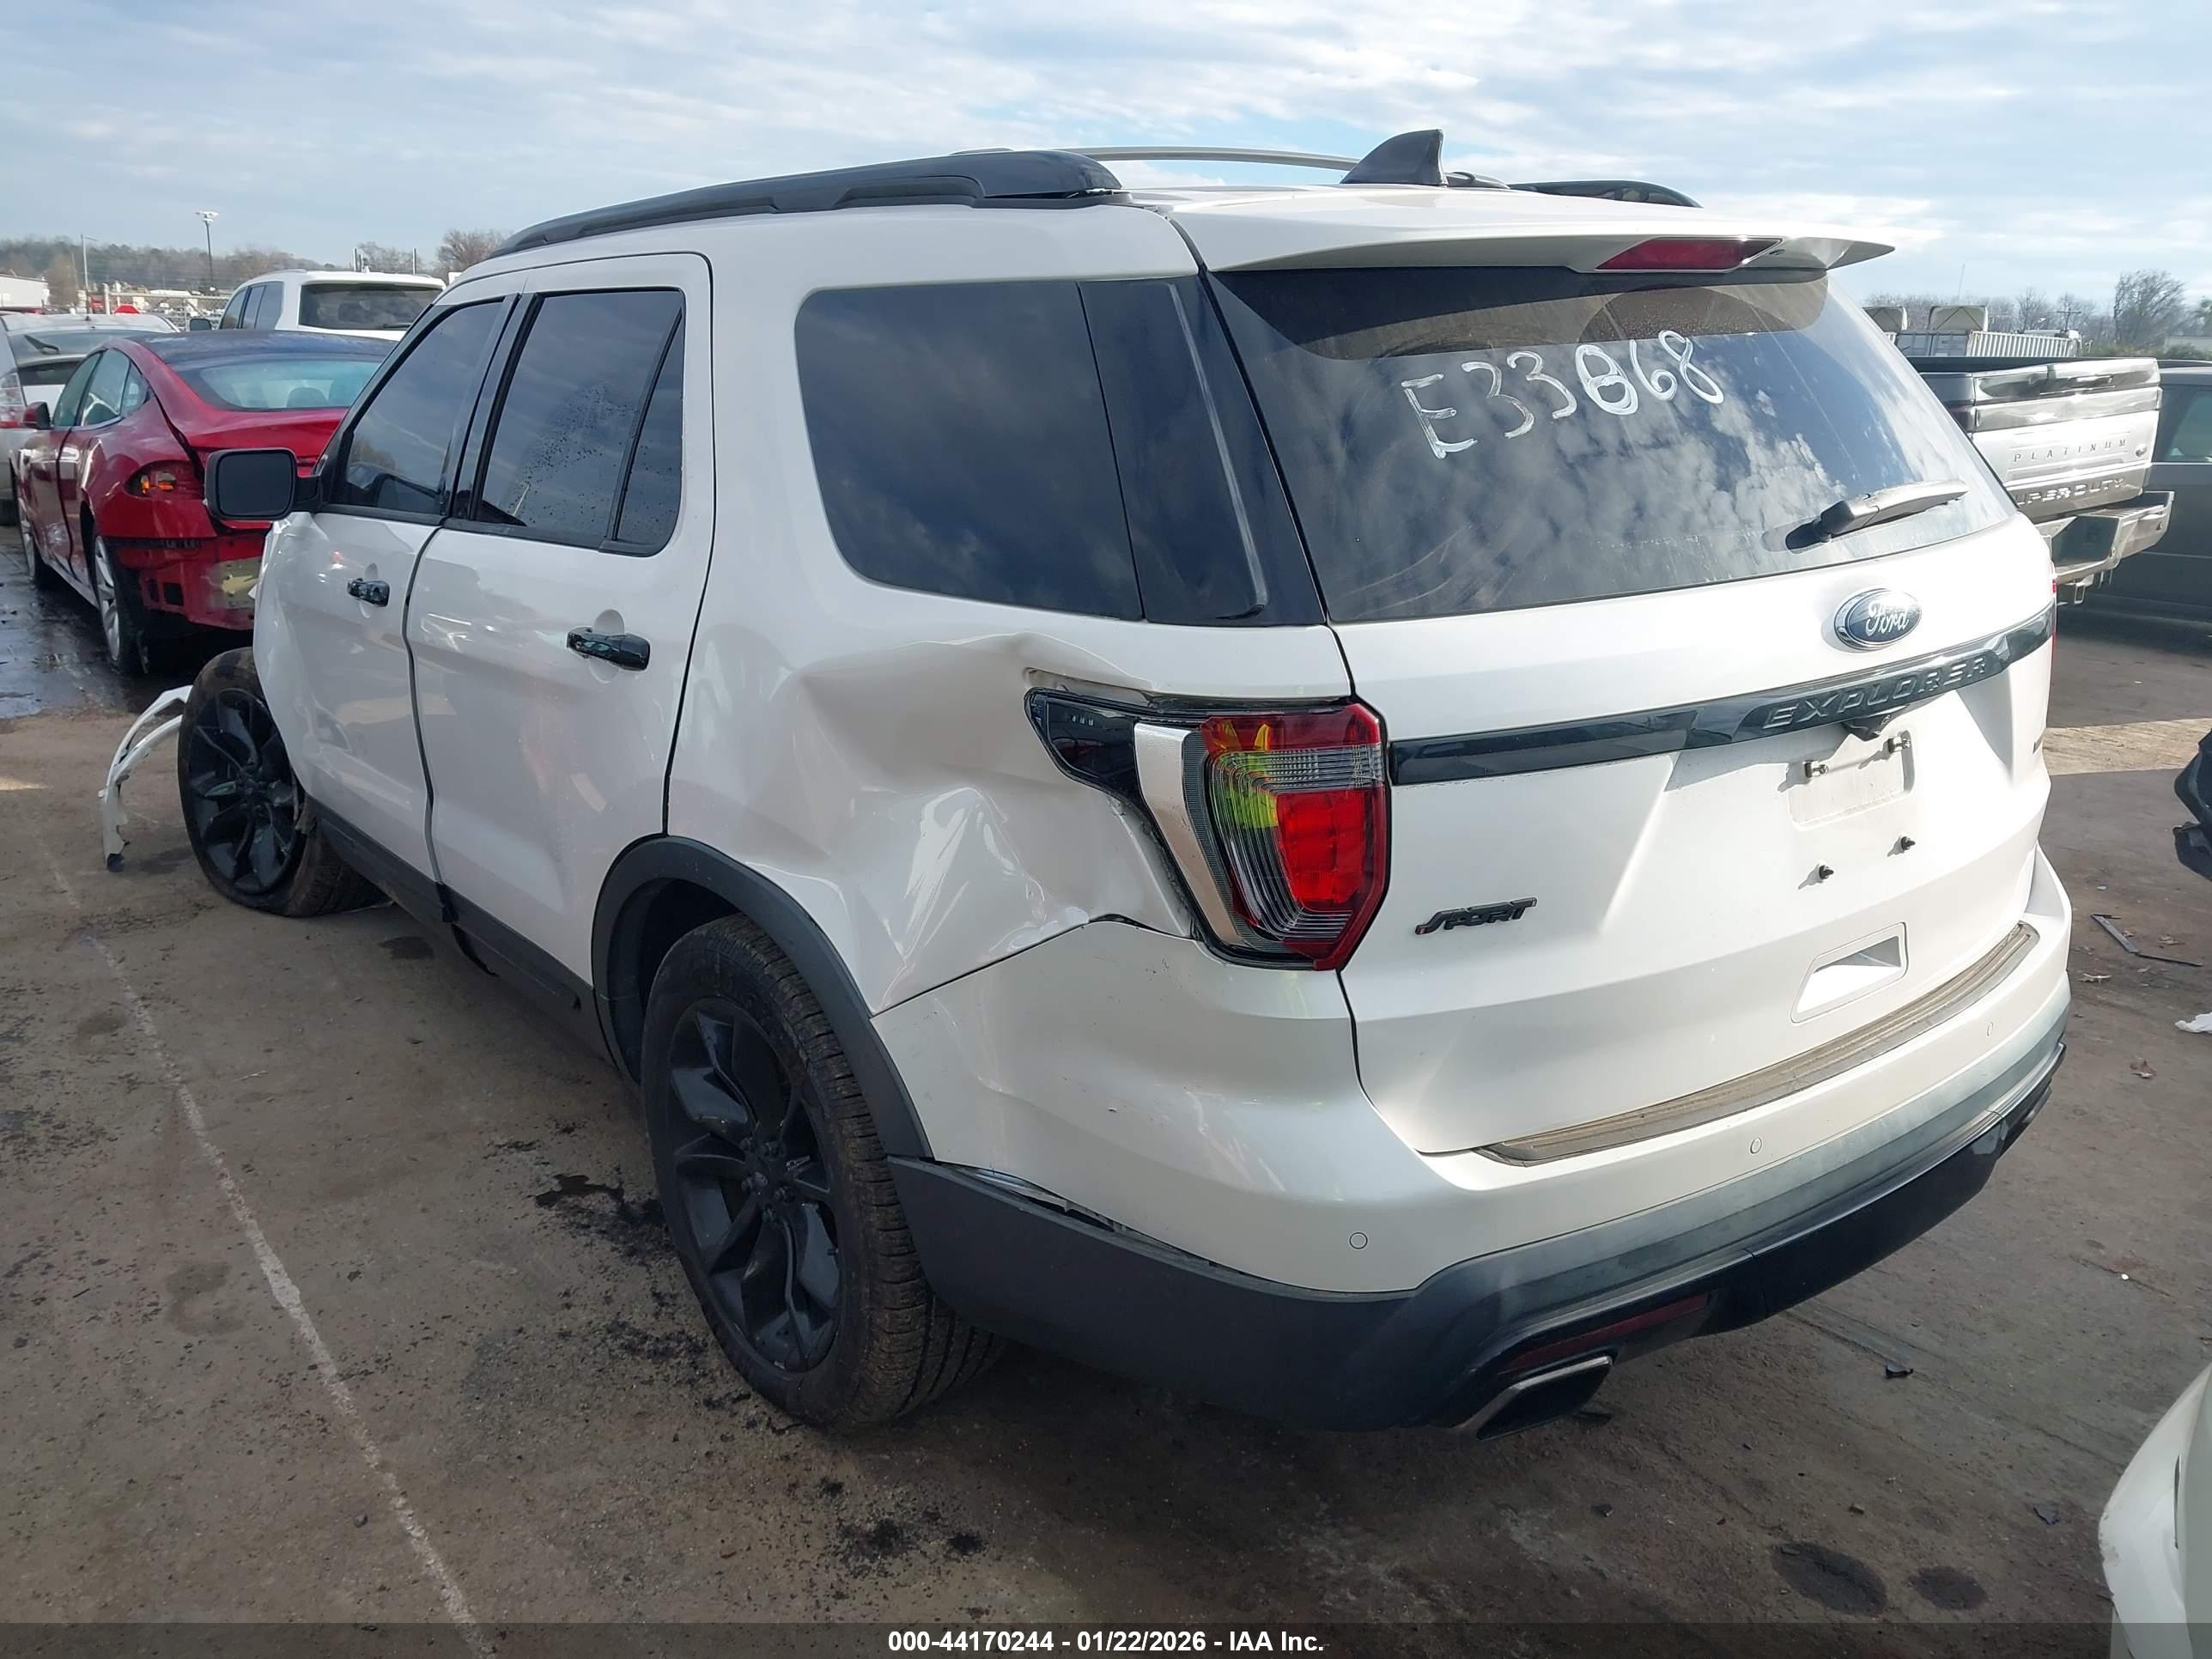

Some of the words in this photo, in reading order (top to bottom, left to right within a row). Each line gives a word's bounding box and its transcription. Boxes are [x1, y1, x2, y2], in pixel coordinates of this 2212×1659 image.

[2014, 439, 2126, 462] PLATINUM
[2014, 487, 2072, 506] UPER
[1865, 601, 1911, 637] Ford
[1763, 655, 1987, 730] EXPLORER
[1415, 897, 1537, 935] SPORT
